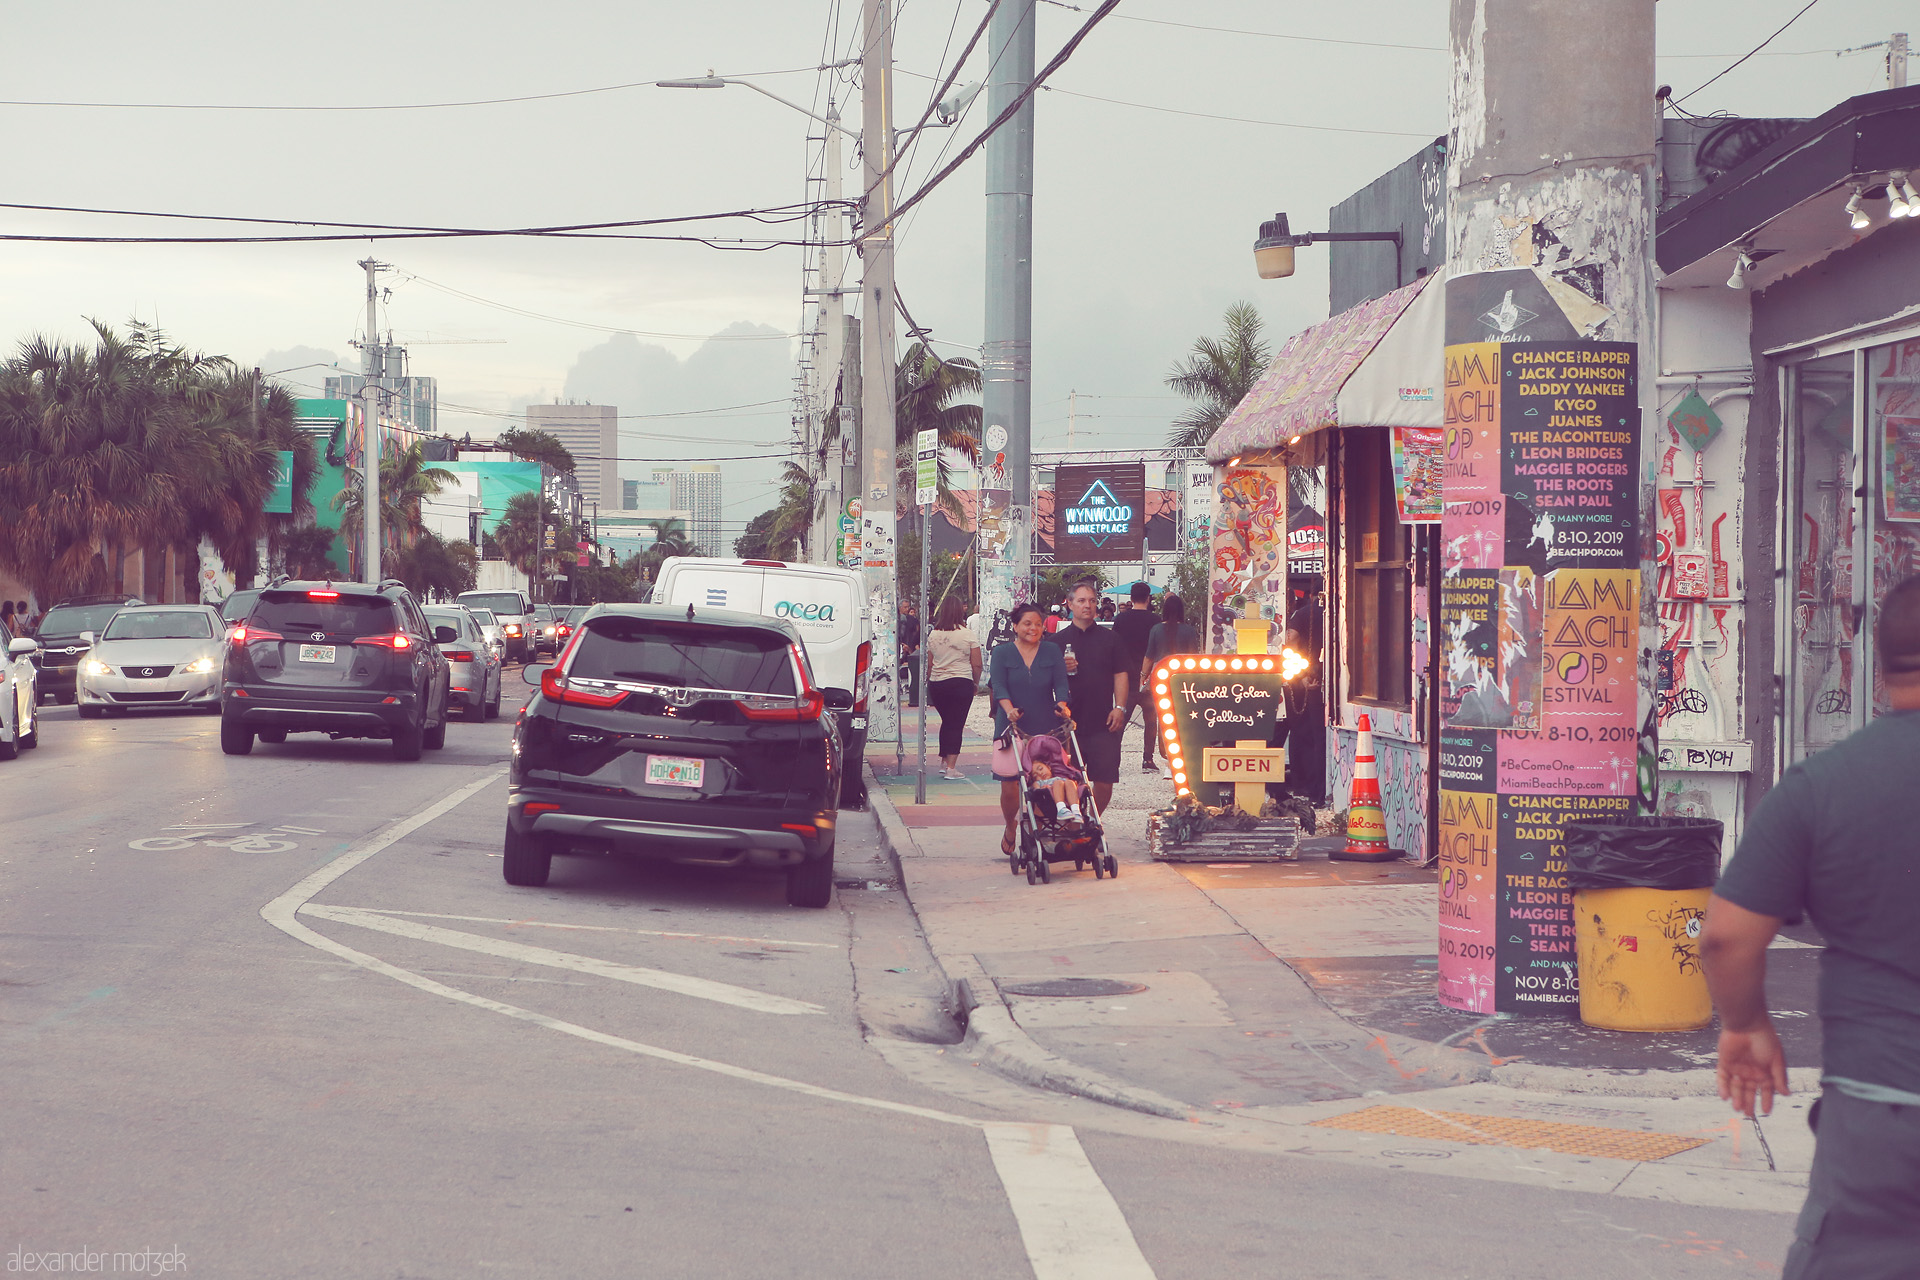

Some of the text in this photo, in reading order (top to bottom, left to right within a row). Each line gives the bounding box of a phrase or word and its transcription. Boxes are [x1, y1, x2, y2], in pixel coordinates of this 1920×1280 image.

[1512, 351, 1575, 364] CHANCE
[1582, 352, 1630, 364] RAPPER
[1518, 367, 1625, 380] JACK JOHNSON
[1519, 383, 1625, 396] DADDY YANKEE
[1554, 399, 1597, 412] KYGO
[1547, 415, 1603, 427] JUANES
[1510, 431, 1632, 444] THE RACONTEURS
[1522, 447, 1623, 460] LEON BRIDGES
[1514, 463, 1628, 476] MAGGIE ROGERS
[1534, 479, 1613, 491] THE ROOTS
[1090, 496, 1106, 505] THE
[1535, 495, 1613, 507] SEAN PAUL
[1065, 505, 1132, 523] WYNWOOD
[1465, 500, 1502, 515] 2019
[1557, 515, 1584, 523] MANY
[1586, 515, 1613, 523] MORE!
[1067, 523, 1129, 534] MARKETPLACE
[1557, 531, 1624, 545] 8-10, 2019
[775, 601, 835, 621] ocea
[1181, 682, 1270, 703] Harold Golen
[1204, 708, 1254, 727] Gallery
[568, 734, 603, 743] CR-V
[1549, 727, 1594, 744] 8-10,
[1598, 727, 1636, 742] 2019
[1217, 758, 1270, 772] OPEN
[1458, 755, 1483, 768] 2019
[1501, 759, 1575, 771] #BeComeOne
[1501, 777, 1604, 791] MiamiBeachPop.com
[1508, 796, 1572, 809] CHANCE
[1579, 798, 1630, 810] RAPPER
[1515, 812, 1552, 824] JACK
[1515, 828, 1565, 840] DADDY
[1506, 875, 1534, 887] THE
[1517, 892, 1557, 904] LEON
[1510, 908, 1568, 921] MAGGIE
[1528, 924, 1558, 937] THE
[1460, 943, 1495, 960] 2019
[1530, 941, 1570, 953] SEAN
[1530, 960, 1550, 968] AND
[1515, 976, 1549, 989] NOV
